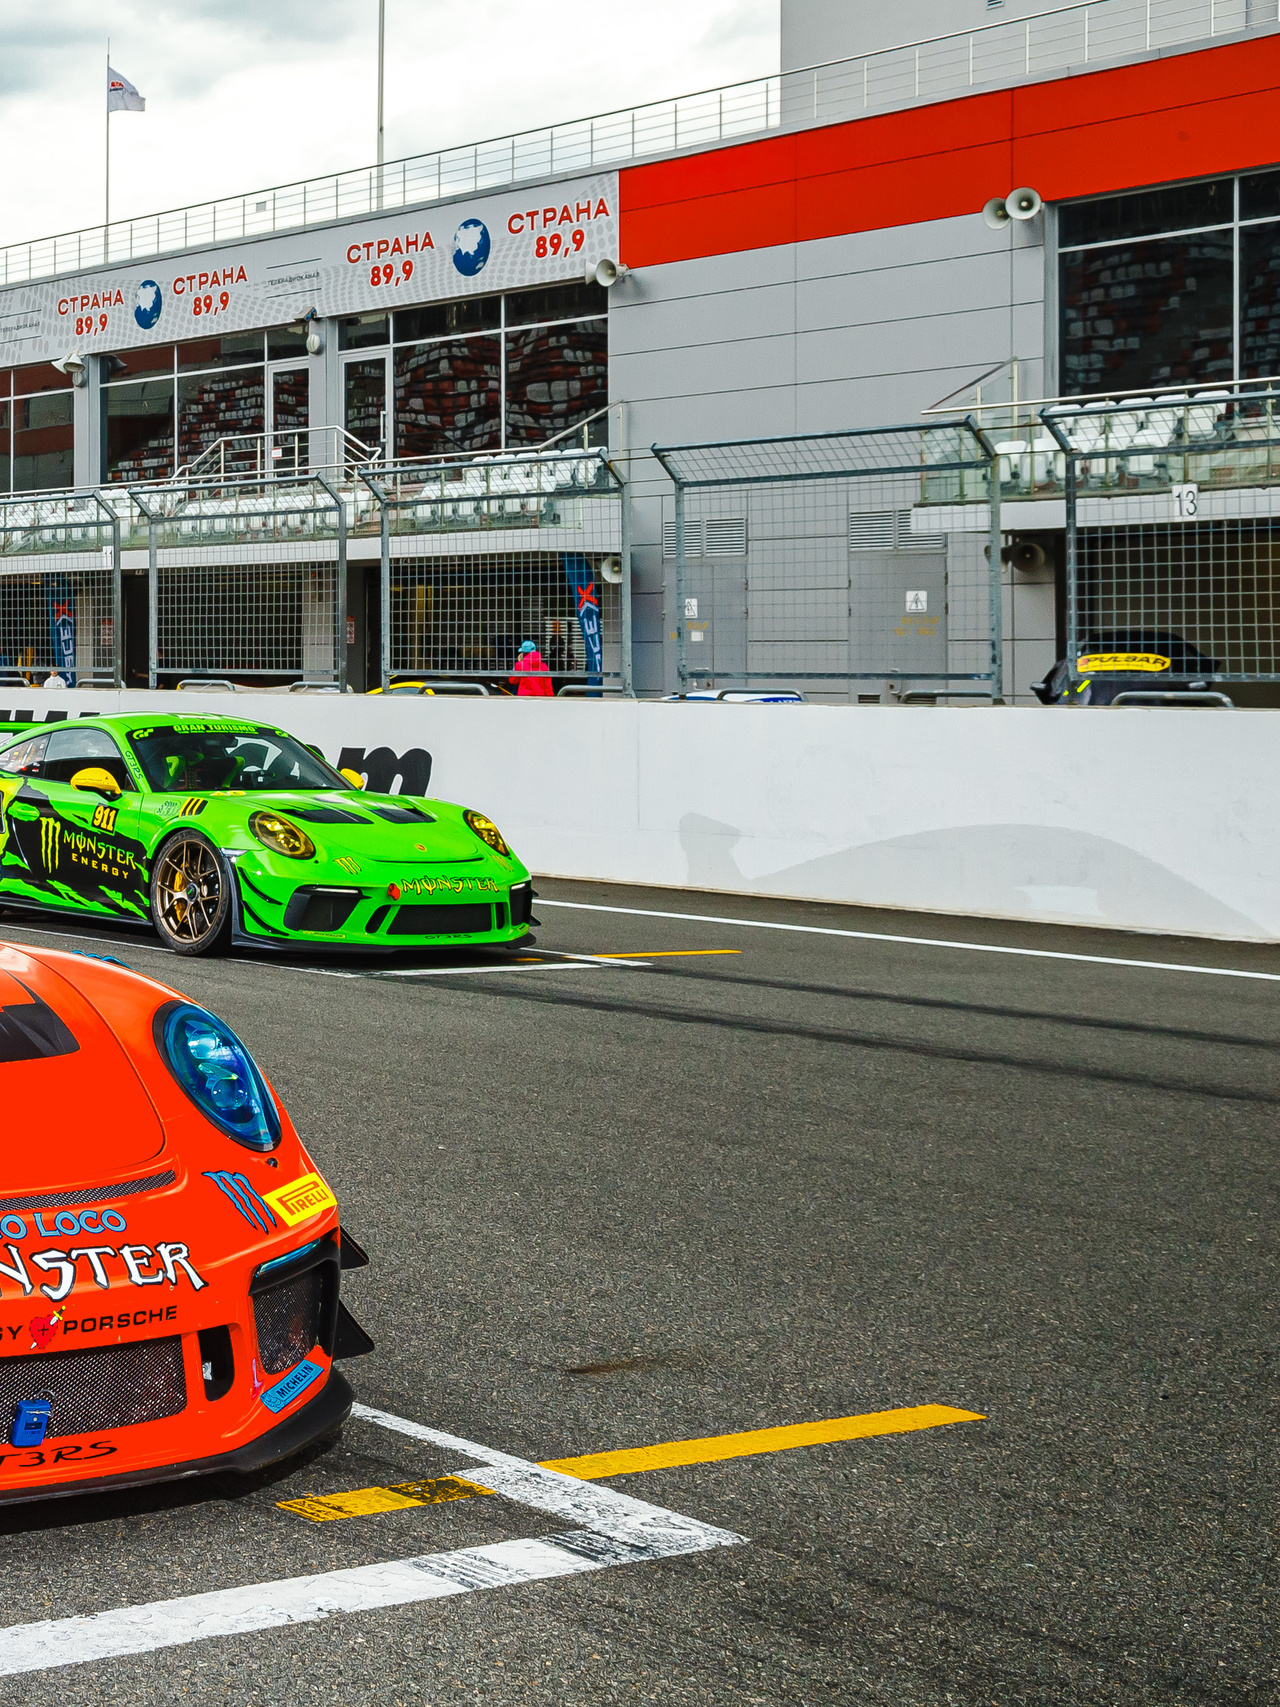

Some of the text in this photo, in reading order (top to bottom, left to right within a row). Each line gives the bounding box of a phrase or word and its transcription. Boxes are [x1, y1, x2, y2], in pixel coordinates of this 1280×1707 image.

[507, 197, 610, 235] СТРАНА
[346, 231, 435, 264] СТРАНА
[535, 229, 585, 259] 89,9
[172, 265, 248, 295] СТРАНА
[370, 260, 414, 287] 89,9
[57, 289, 124, 316] СТРАНА
[192, 291, 230, 316] 89,9
[75, 313, 108, 336] 89,9
[1176, 491, 1198, 515] 13
[93, 805, 116, 831] 911
[63, 829, 137, 871] MONSTER
[72, 853, 128, 879] ENERGY
[401, 875, 499, 895] MONSTER
[276, 1180, 329, 1216] PIRELLI
[33, 1209, 127, 1238] LOCO
[63, 1305, 178, 1336] PORSCHE
[276, 1363, 313, 1398] MICHELIN
